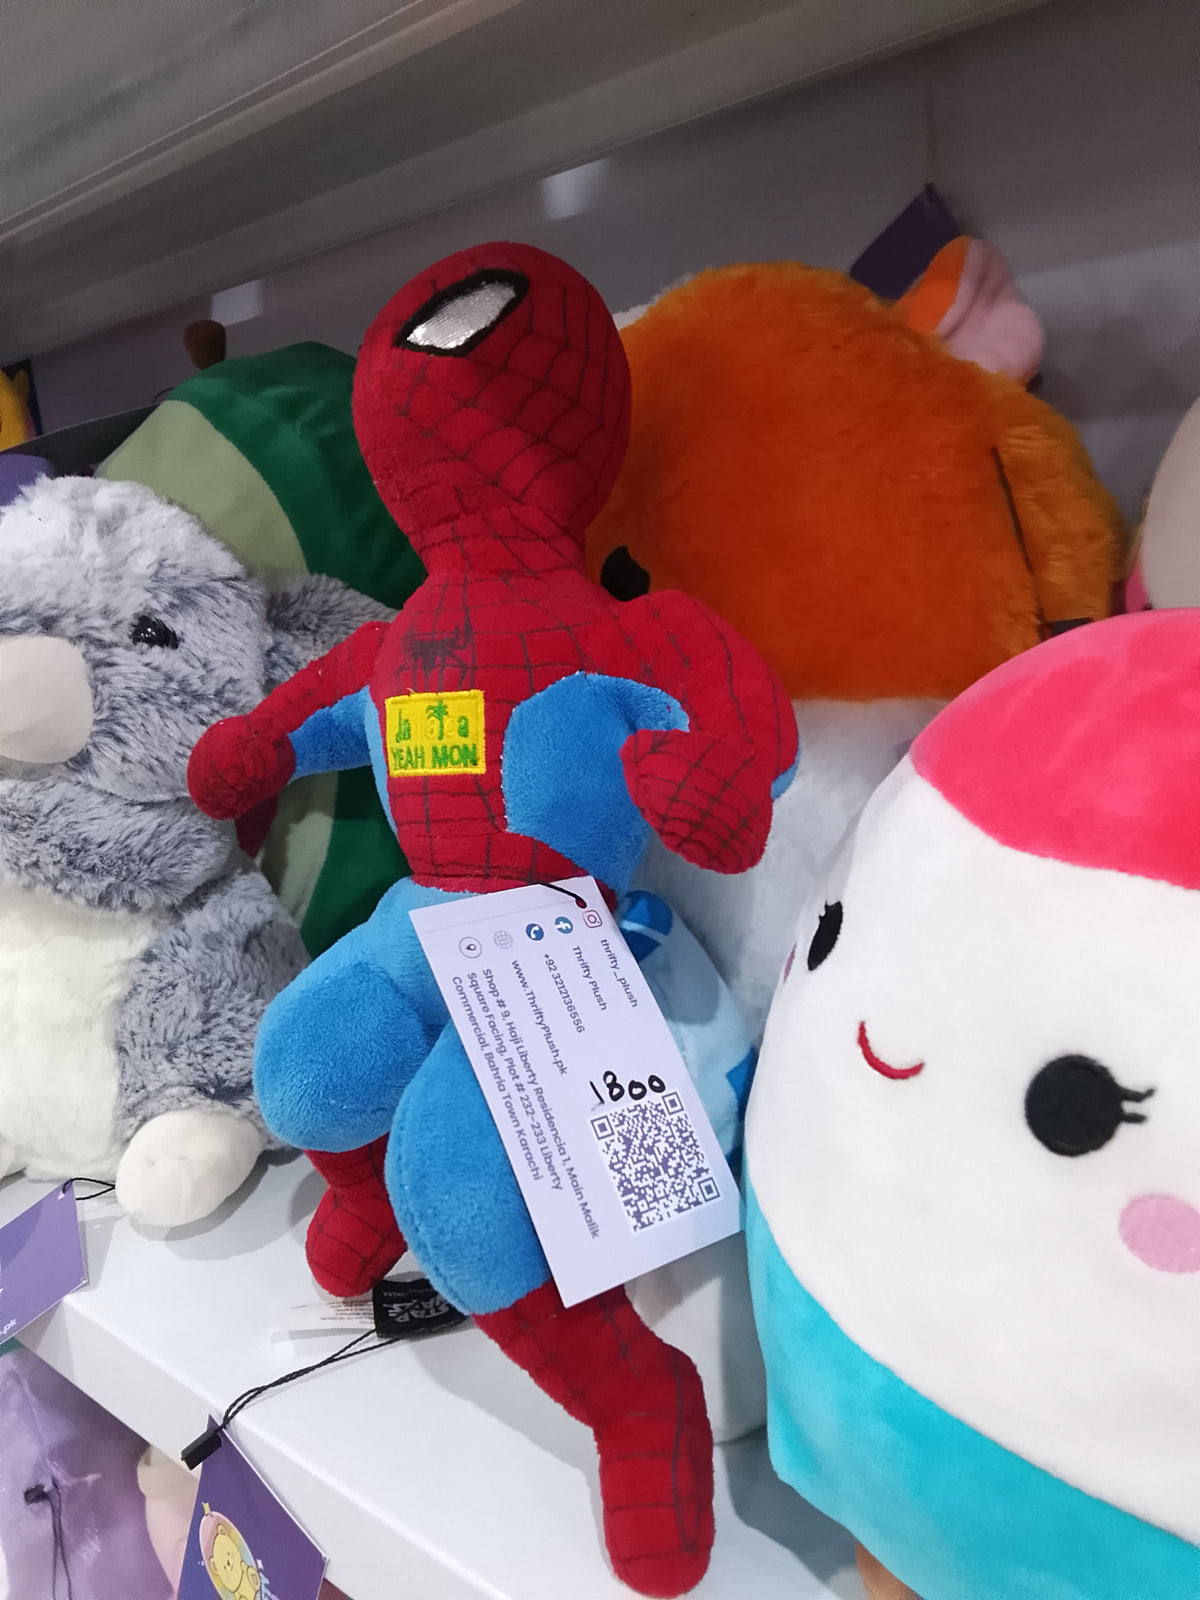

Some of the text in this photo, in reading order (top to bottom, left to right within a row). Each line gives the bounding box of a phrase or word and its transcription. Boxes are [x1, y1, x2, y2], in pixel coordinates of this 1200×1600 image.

[391, 744, 477, 771] YEAH MON
[543, 953, 586, 1034] +92 3212136556
[572, 945, 607, 1011] Thrifty Plush
[600, 938, 638, 1008] thrifty_plush
[511, 959, 568, 1076] www.ThriftyPlush.pk
[452, 976, 544, 1181] Commercial, Bahria Town Karachi
[467, 972, 563, 1190] Square Facing, Plot # 232-233 Liberty
[482, 968, 600, 1239] Shop # 9, Haji Liberty Residencia 1, Main Malik
[590, 1070, 665, 1103] 1800
